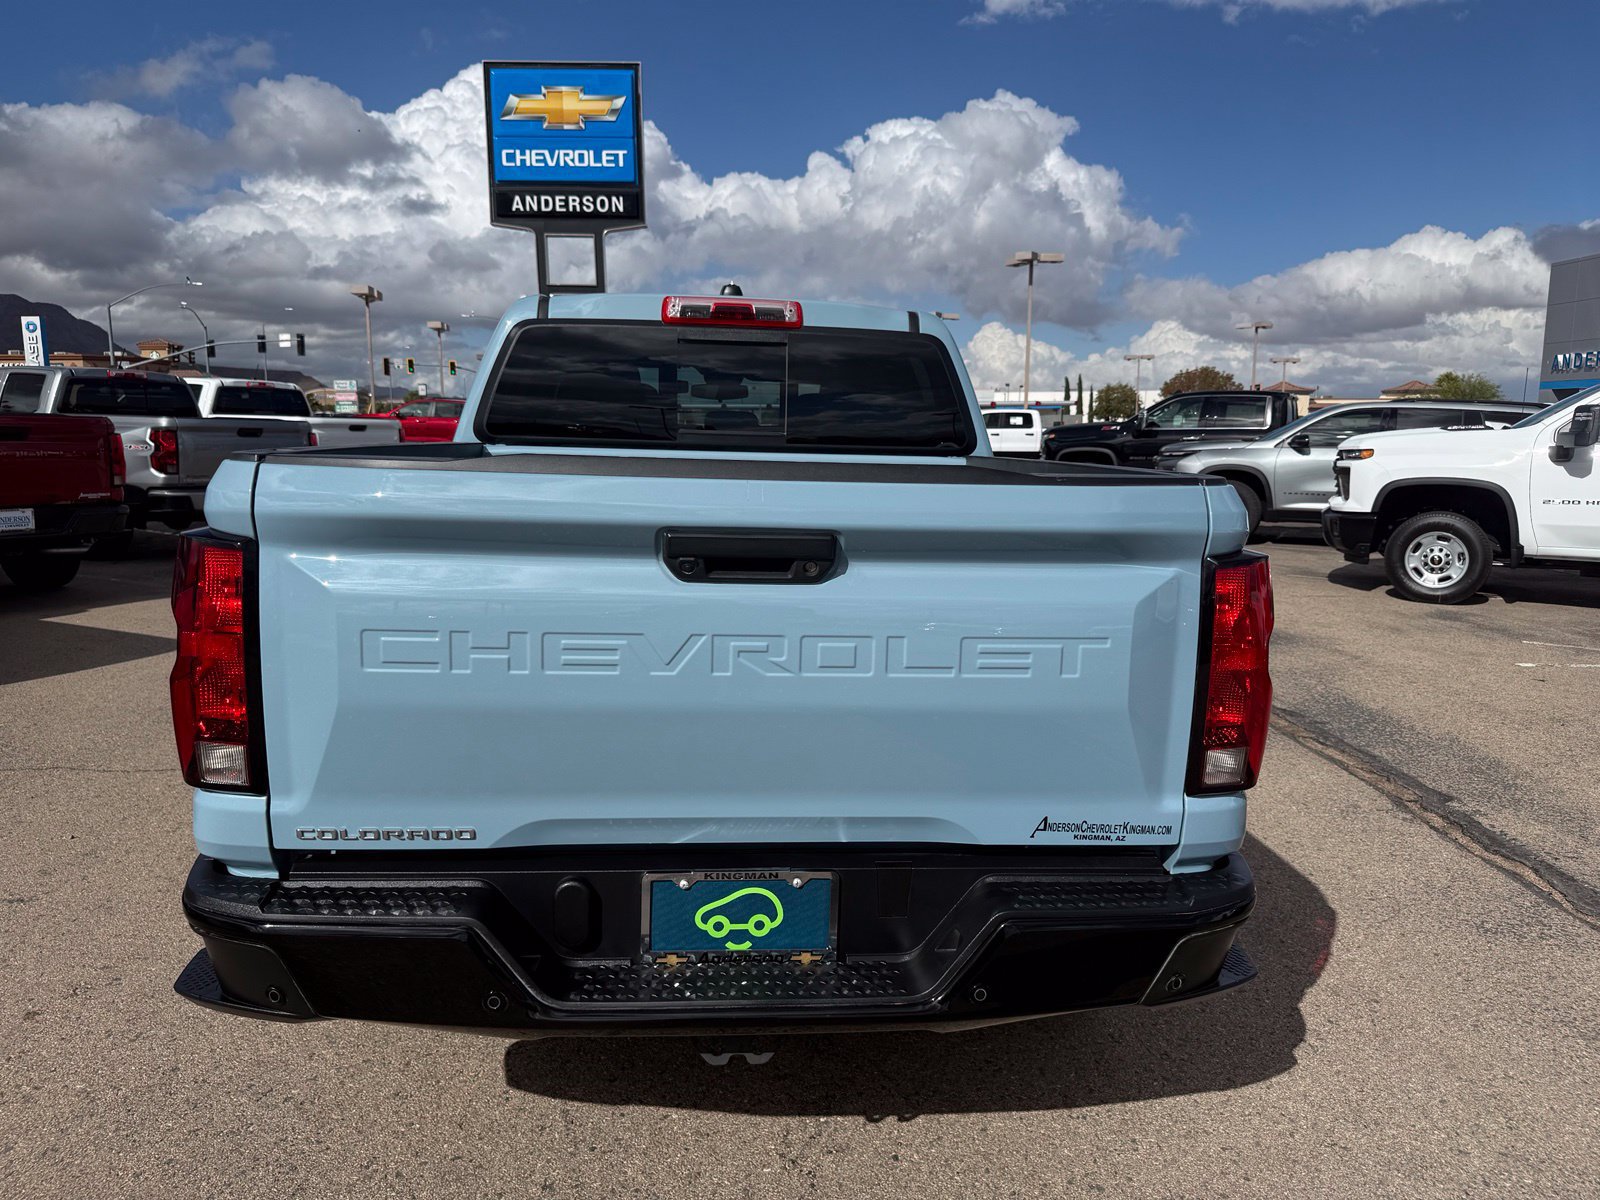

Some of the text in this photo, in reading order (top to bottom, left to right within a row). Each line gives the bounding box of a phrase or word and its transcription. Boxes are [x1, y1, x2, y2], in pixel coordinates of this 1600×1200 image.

[501, 149, 628, 168] CHEVROLET
[511, 195, 625, 213] ANDERSON
[360, 628, 1111, 678] CHEVROLET
[296, 826, 477, 841] COLORADO
[1073, 834, 1113, 842] KINGMAN,
[703, 872, 779, 880] KINGMAN
